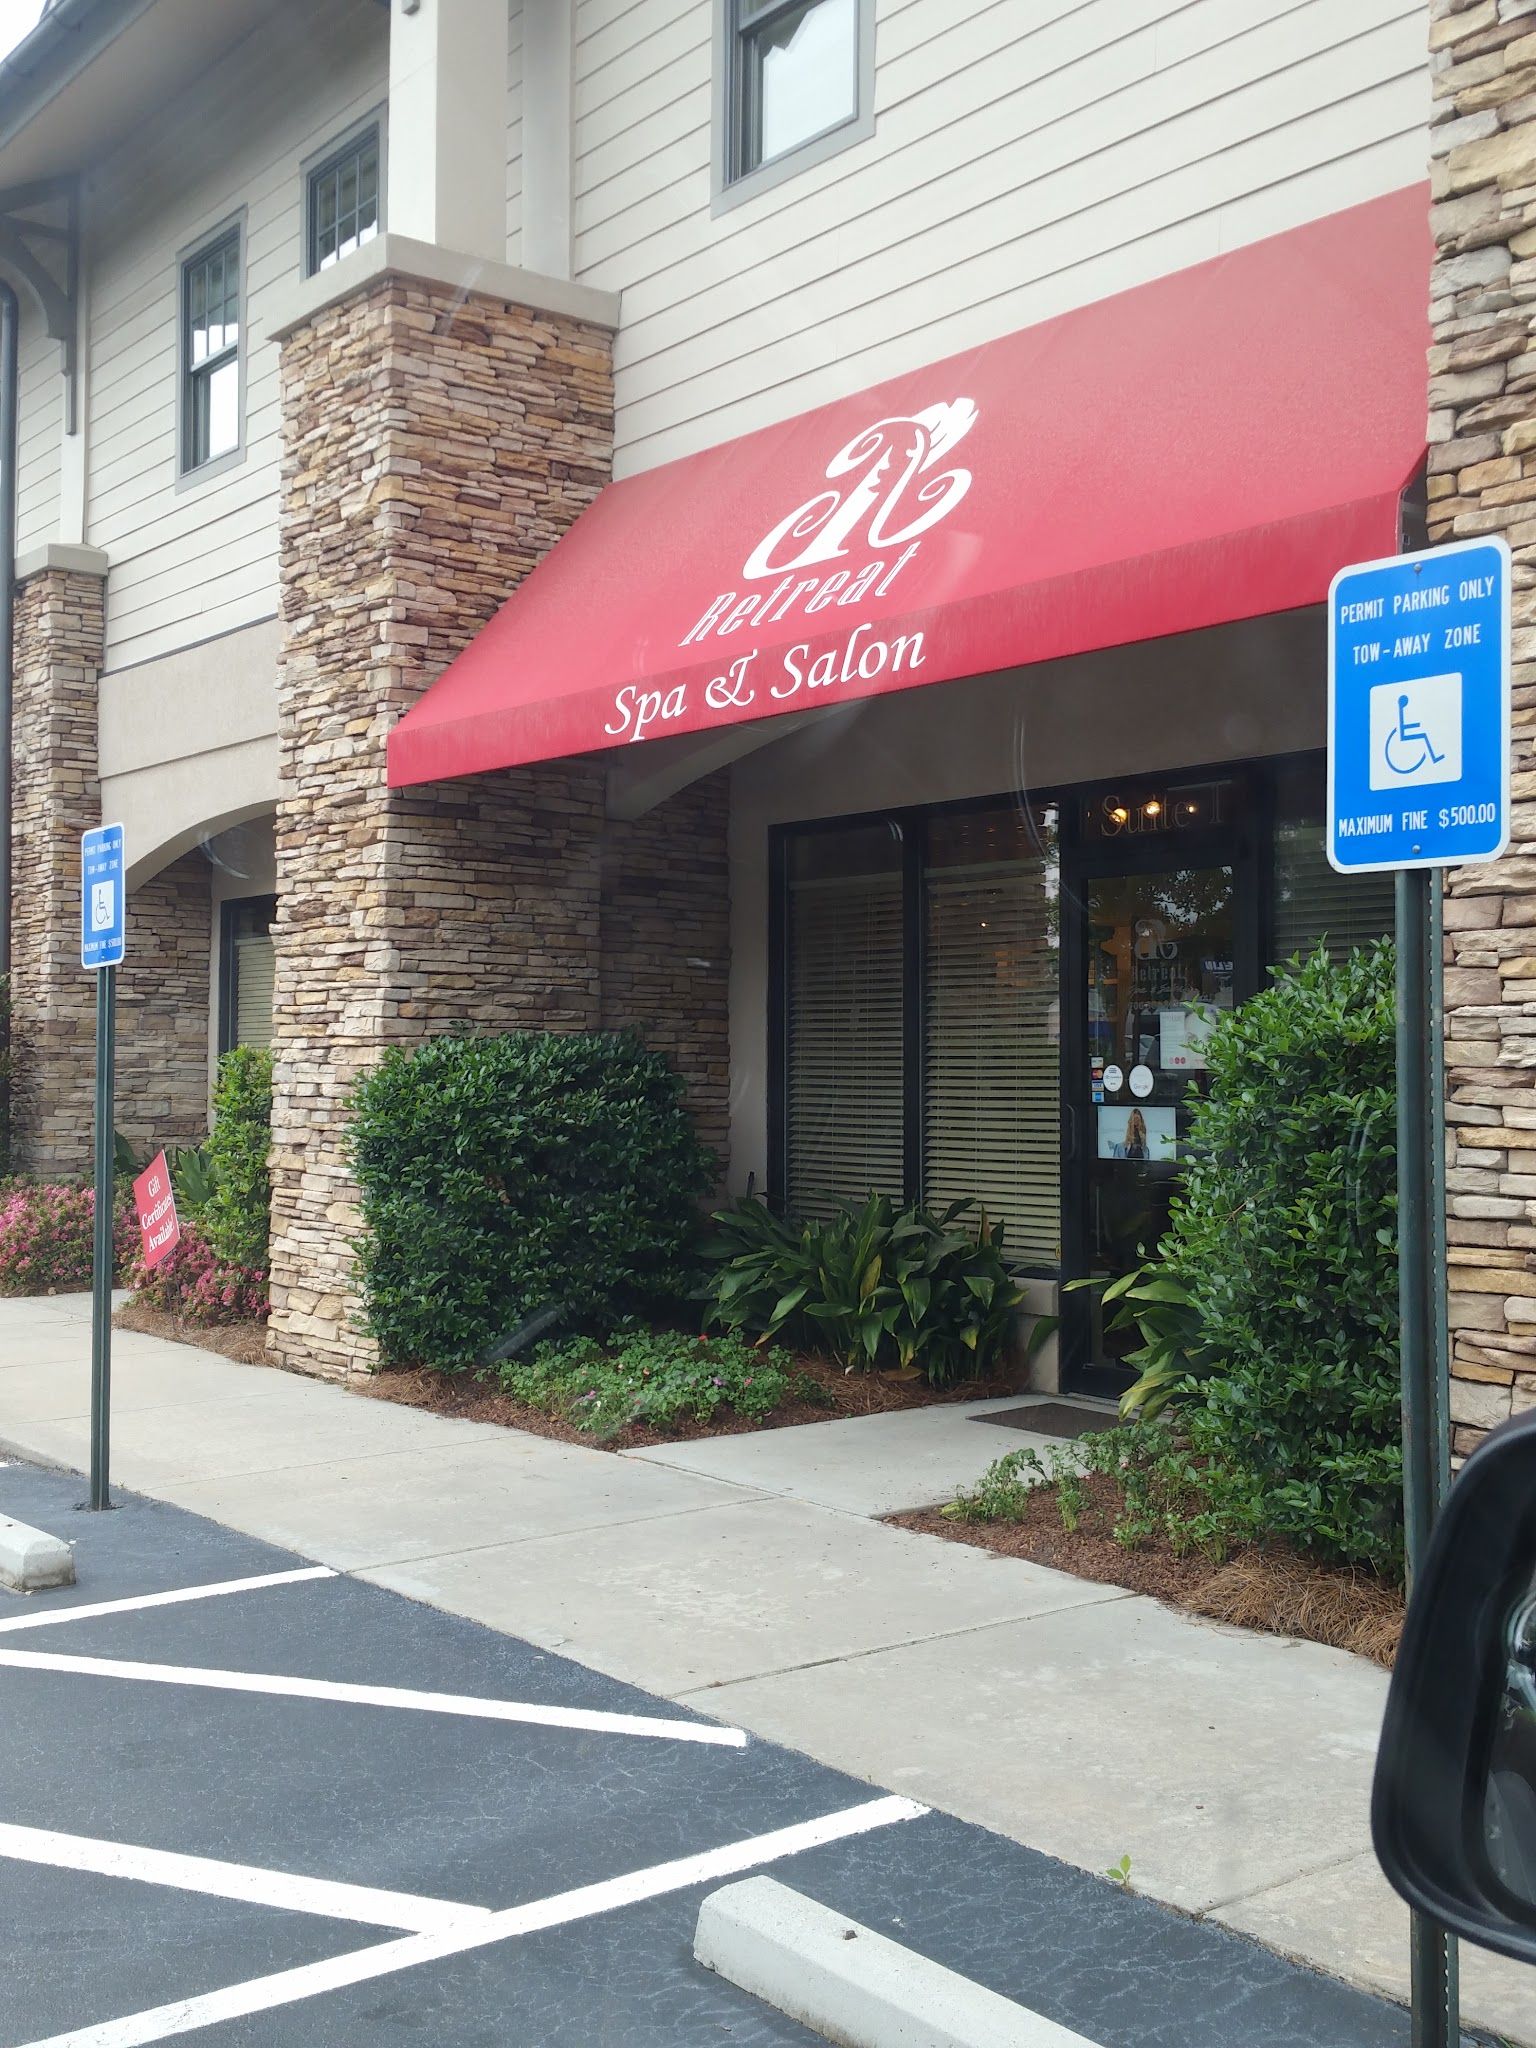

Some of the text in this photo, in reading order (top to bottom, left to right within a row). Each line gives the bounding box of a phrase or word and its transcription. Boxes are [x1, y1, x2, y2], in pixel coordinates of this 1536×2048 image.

[678, 540, 922, 647] Retreat
[1340, 576, 1495, 625] PERMIT PARKING ONLY
[1444, 624, 1482, 650] ZONE
[604, 623, 927, 743] Spa & Salon
[1101, 794, 1190, 836] Suite
[1339, 802, 1497, 838] MAXIMUM FINE $500.00
[148, 1176, 160, 1197] Gift
[141, 1194, 173, 1230] Certificates
